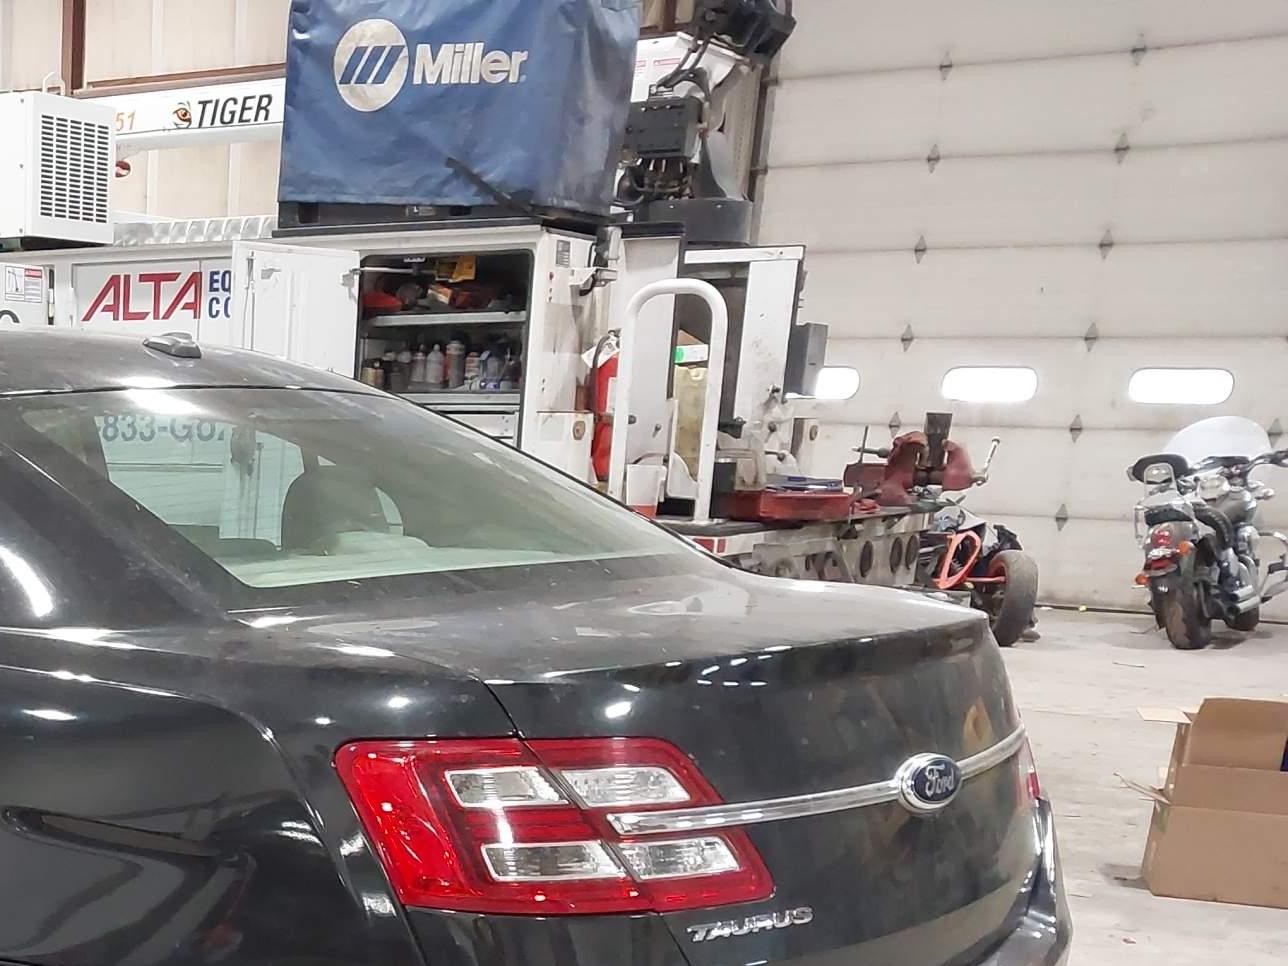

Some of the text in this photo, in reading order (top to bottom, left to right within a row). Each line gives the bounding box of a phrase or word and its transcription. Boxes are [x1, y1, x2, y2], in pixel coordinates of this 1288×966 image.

[413, 43, 529, 85] Miller
[198, 94, 273, 128] TIGER
[81, 272, 203, 321] ALTA
[925, 763, 954, 797] Ford
[687, 907, 813, 942] TAURUS
